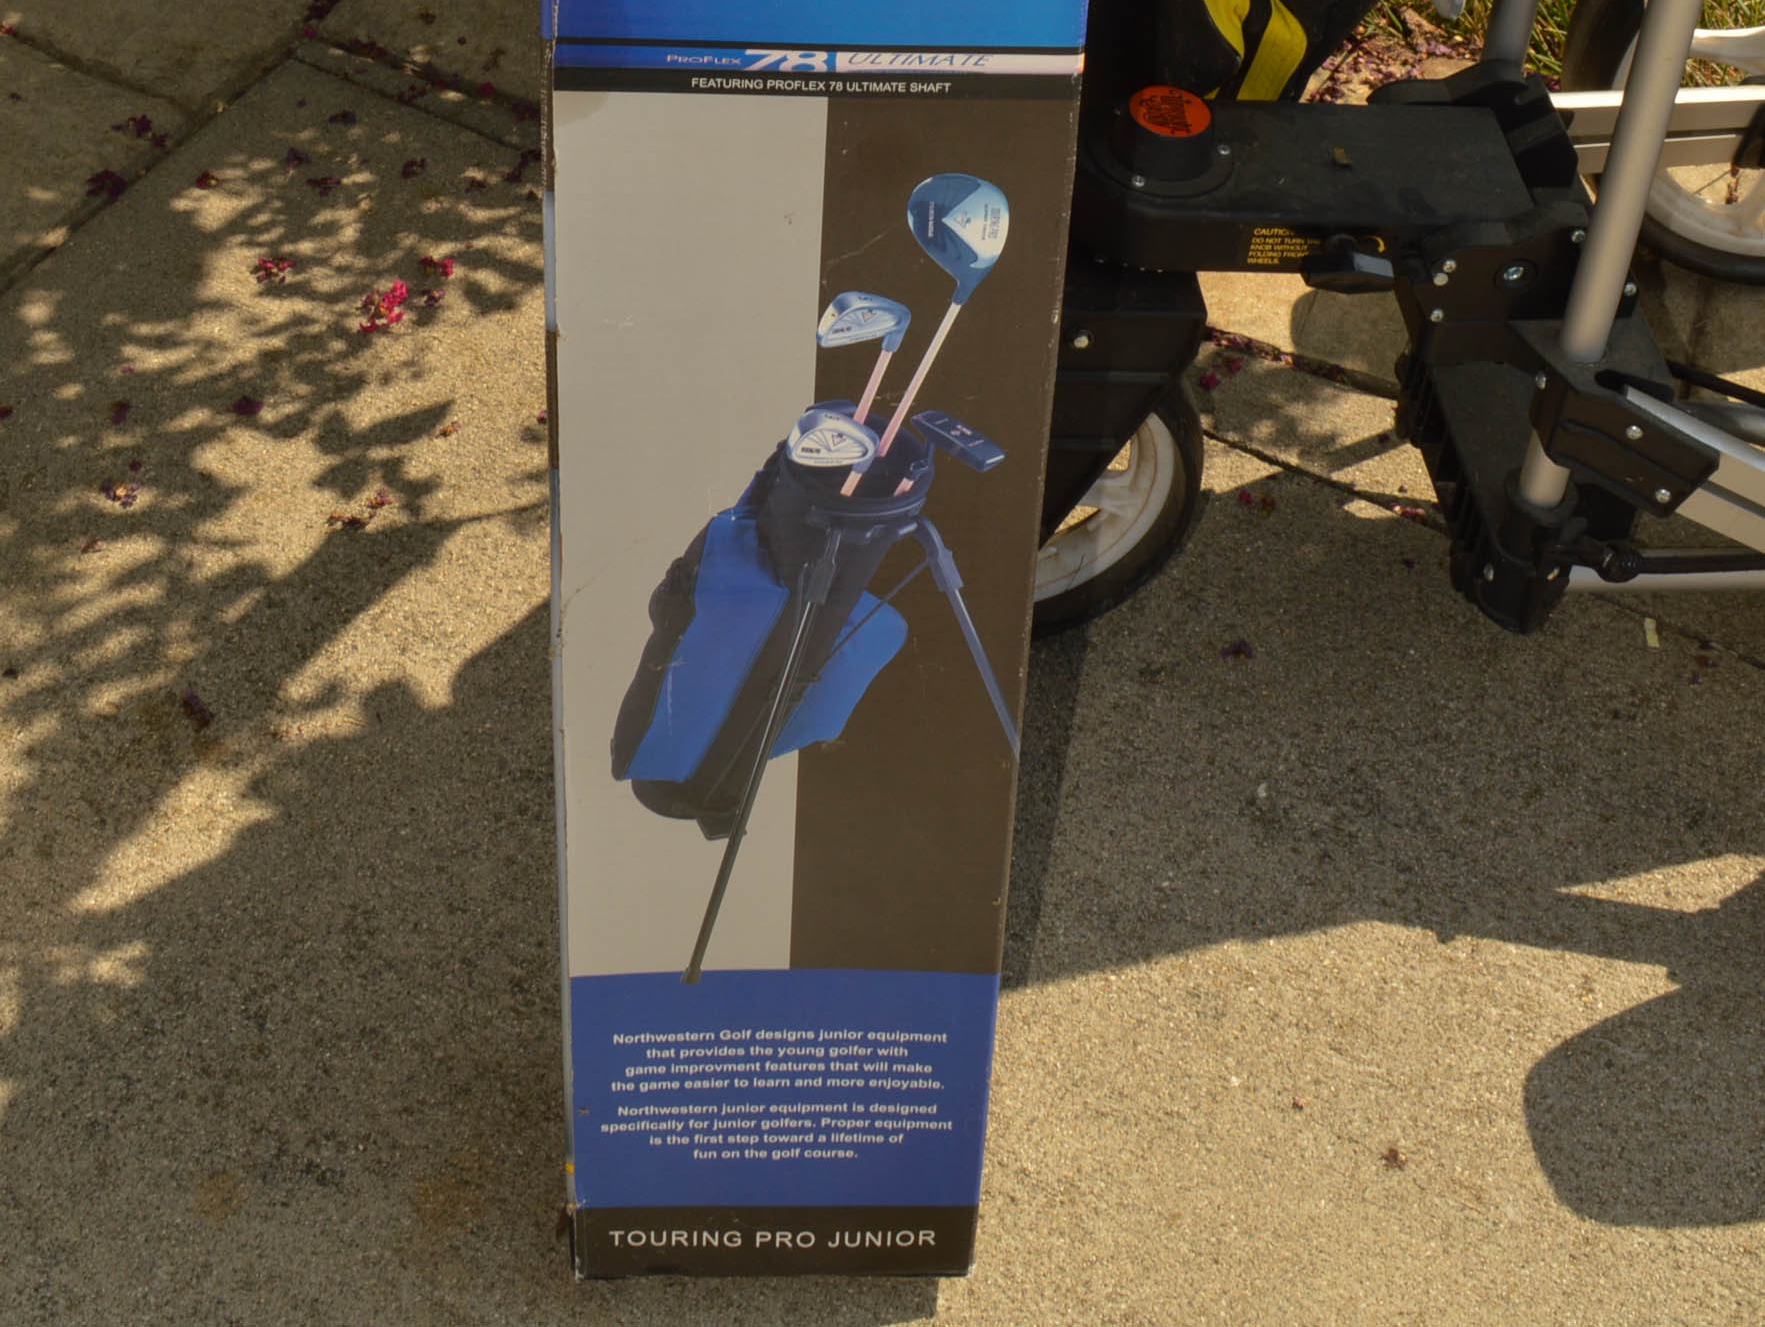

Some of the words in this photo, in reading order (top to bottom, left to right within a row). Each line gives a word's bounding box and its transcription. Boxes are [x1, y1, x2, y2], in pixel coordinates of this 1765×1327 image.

[743, 49, 828, 72] 78
[847, 52, 993, 66] ULTIMATE
[691, 77, 764, 90] FEATURING
[767, 79, 825, 91] PROFLEX
[829, 80, 843, 91] 78
[846, 81, 906, 92] ULTIMATE
[910, 82, 952, 93] SHAFT
[613, 1031, 715, 1045] Northwestern
[720, 1029, 752, 1041] Golf
[755, 1029, 815, 1042] designs
[818, 1028, 863, 1042] junior
[867, 1030, 947, 1043] equipment
[646, 1048, 675, 1059] that
[680, 1046, 745, 1059] provides
[750, 1045, 773, 1056] the
[778, 1046, 825, 1057] young
[829, 1045, 873, 1057] golfer
[877, 1046, 908, 1057] with
[625, 1065, 666, 1077] game
[671, 1061, 761, 1074] improvment
[765, 1061, 826, 1072] features
[830, 1061, 859, 1072] that
[863, 1061, 888, 1072] will
[893, 1063, 932, 1074] make
[611, 1081, 635, 1092] the
[639, 1081, 680, 1092] game
[684, 1078, 730, 1089] easier
[734, 1078, 748, 1088] to
[753, 1077, 790, 1088] learn
[795, 1077, 822, 1087] and
[827, 1078, 865, 1087] more
[869, 1077, 944, 1090] enjoyable.
[618, 1104, 717, 1116] Northwestern
[721, 1103, 765, 1115] junior
[769, 1102, 848, 1115] equipment
[852, 1103, 865, 1113] is
[869, 1103, 937, 1115] designed
[601, 1120, 684, 1134] specifically
[689, 1119, 709, 1129] for
[713, 1118, 757, 1130] junior
[761, 1118, 816, 1130] golfers.
[821, 1117, 871, 1129] Proper
[874, 1118, 952, 1130] equipment
[650, 1135, 662, 1145] is
[666, 1134, 689, 1145] the
[694, 1134, 723, 1144] first
[727, 1134, 759, 1145] step
[763, 1133, 814, 1143] toward
[818, 1135, 827, 1143] a
[831, 1133, 884, 1143] lifetime
[888, 1133, 904, 1143] of
[693, 1149, 717, 1159] fun
[721, 1150, 740, 1159] on
[744, 1148, 767, 1159] the
[772, 1148, 800, 1160] golf
[804, 1149, 858, 1158] course.
[608, 1230, 742, 1248] TOURING
[755, 1230, 815, 1248] PRO
[828, 1230, 936, 1248] JUNIOR
